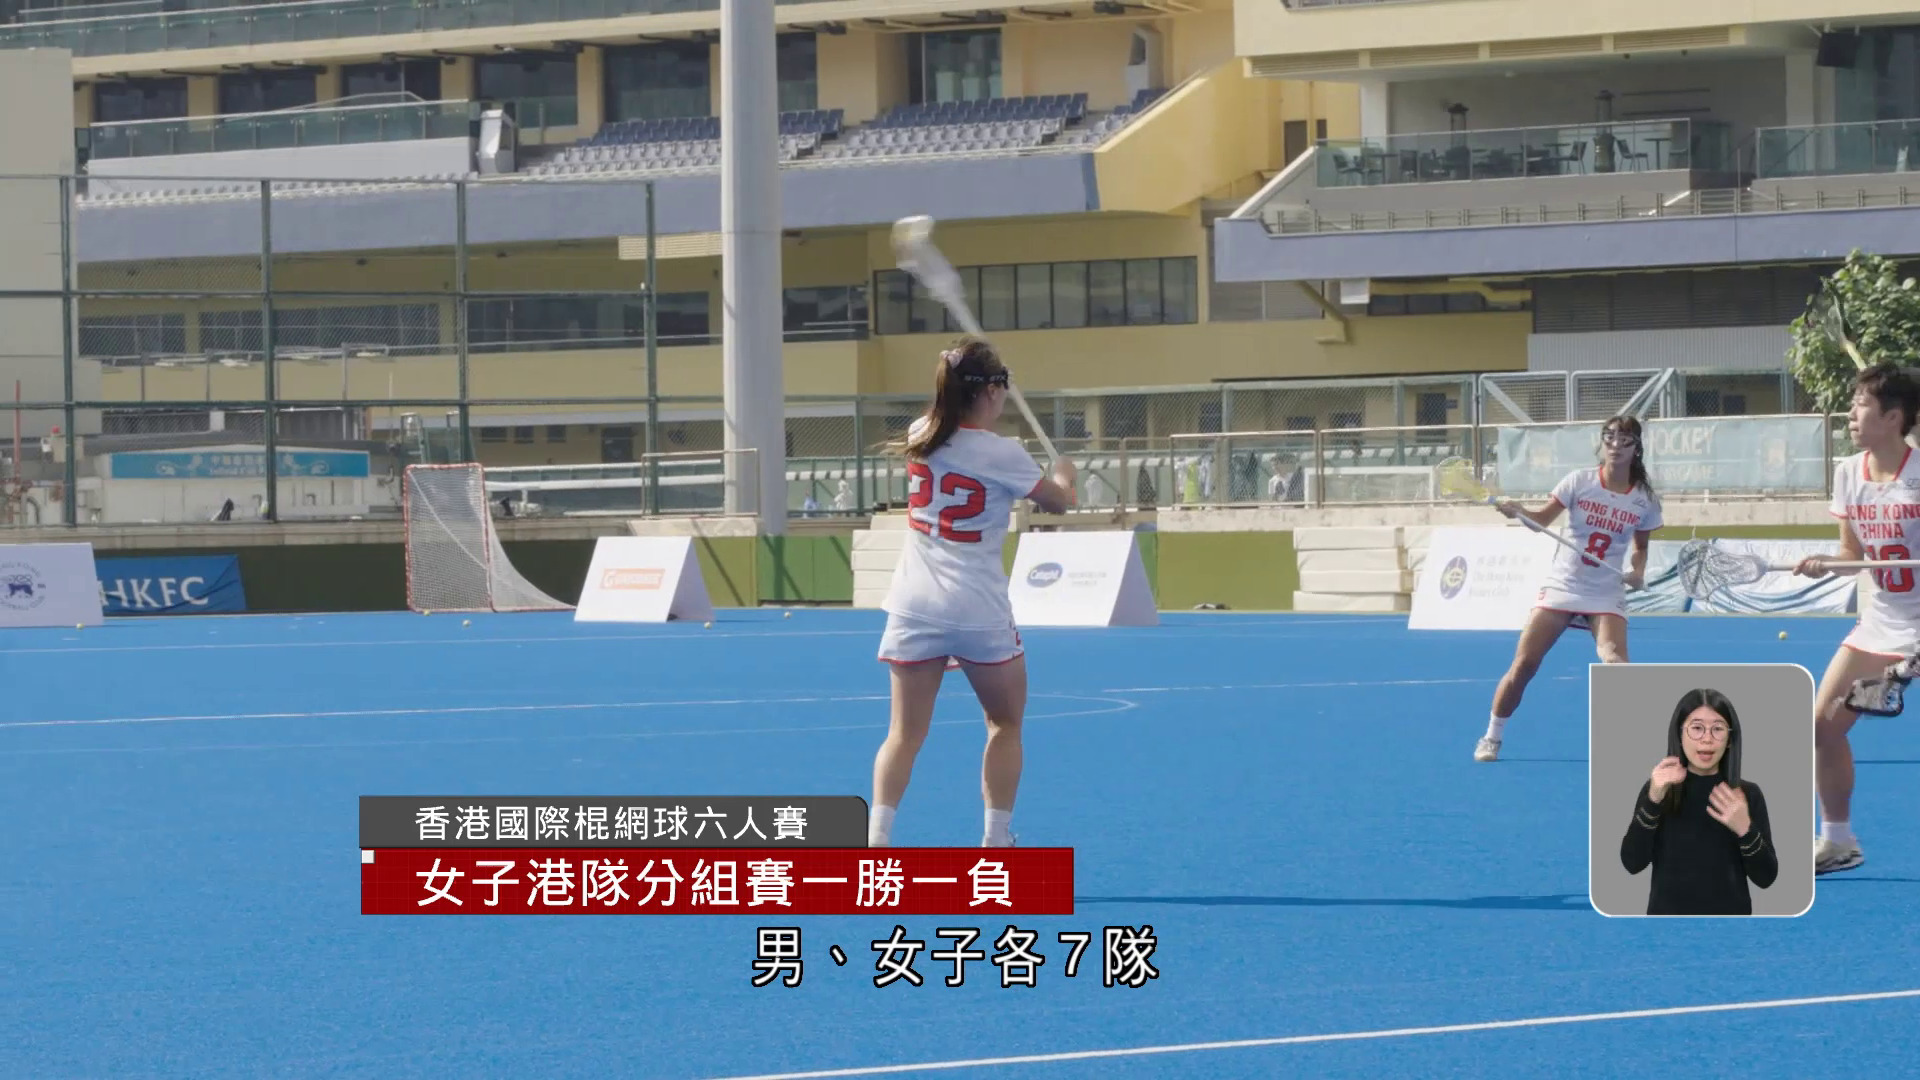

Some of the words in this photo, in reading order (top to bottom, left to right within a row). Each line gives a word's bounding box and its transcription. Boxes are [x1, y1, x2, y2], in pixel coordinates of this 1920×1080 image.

[907, 461, 986, 544] 22
[1577, 499, 1608, 516] HONG
[1586, 514, 1624, 534] CHINA
[1860, 523, 1904, 539] CHINA
[1581, 531, 1612, 568] 8
[99, 576, 208, 608] HKFC
